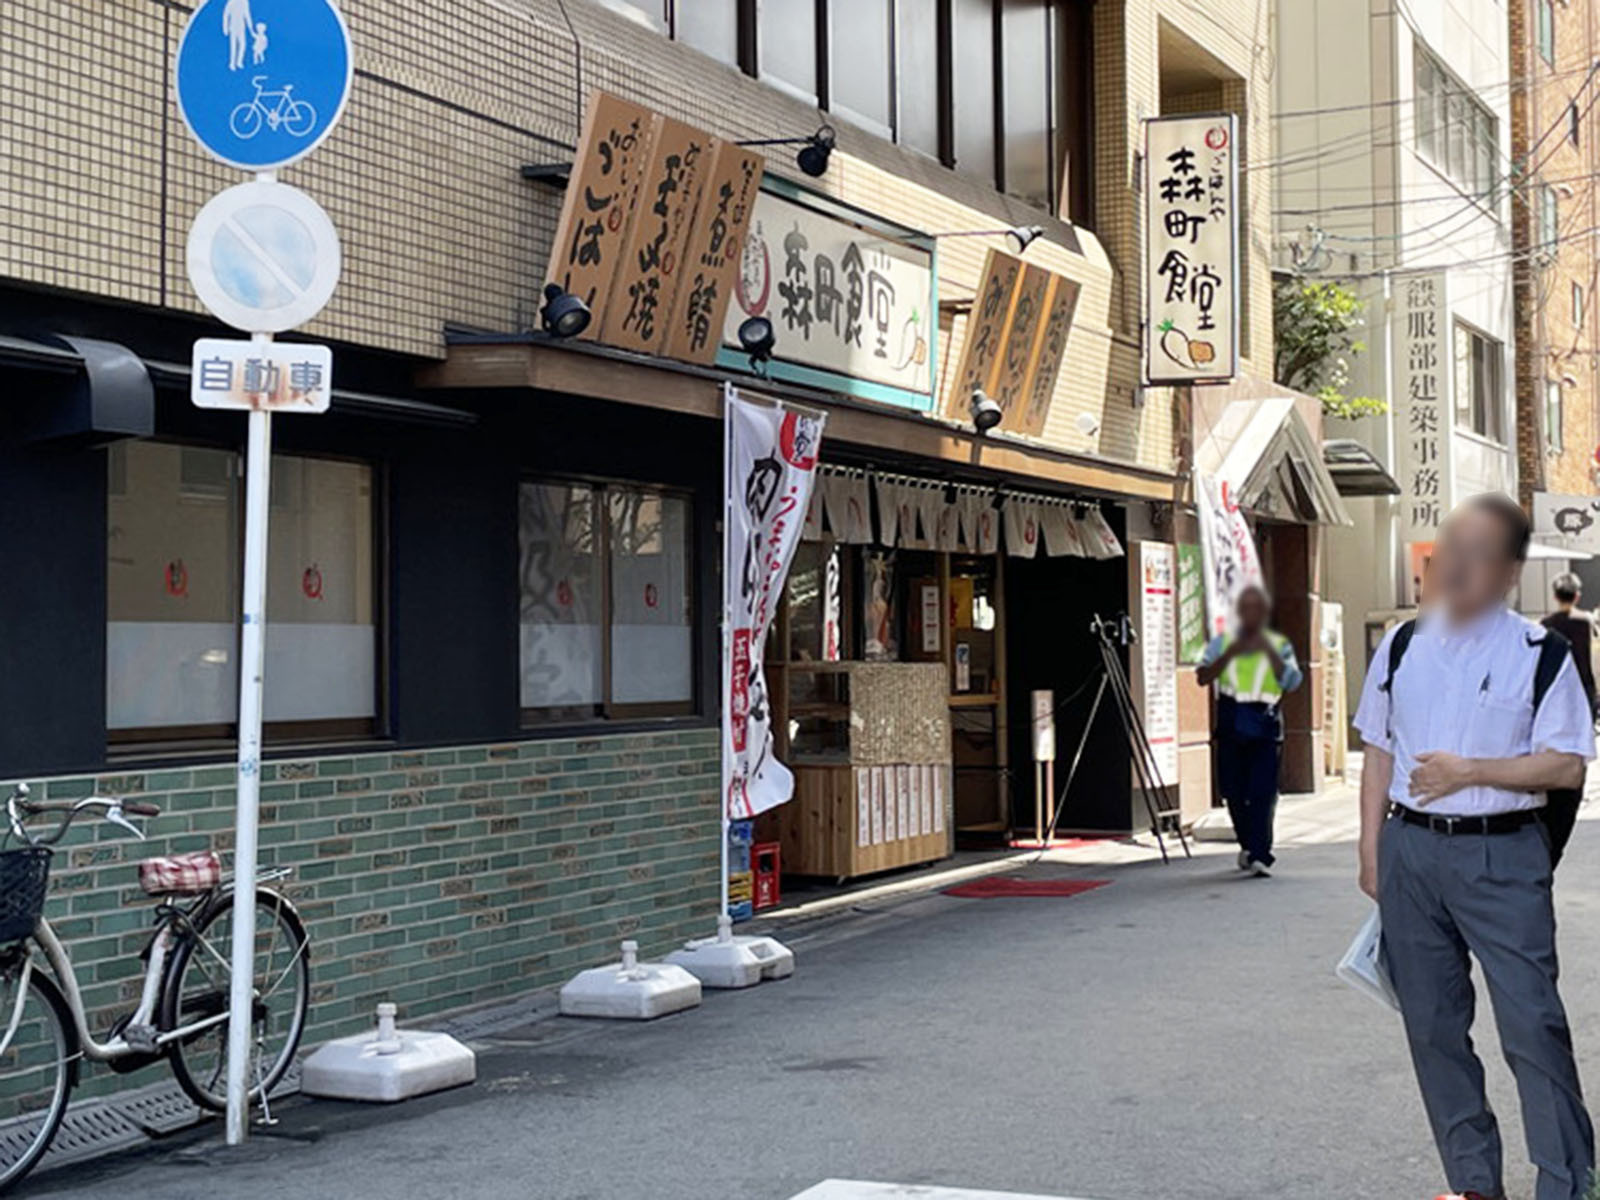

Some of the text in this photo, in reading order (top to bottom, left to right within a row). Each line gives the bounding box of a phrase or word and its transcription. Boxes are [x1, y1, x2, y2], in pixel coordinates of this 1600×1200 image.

[777, 222, 895, 360] 森町食堂
[1158, 147, 1222, 330] 森町食堂
[200, 357, 323, 405] 自動車
